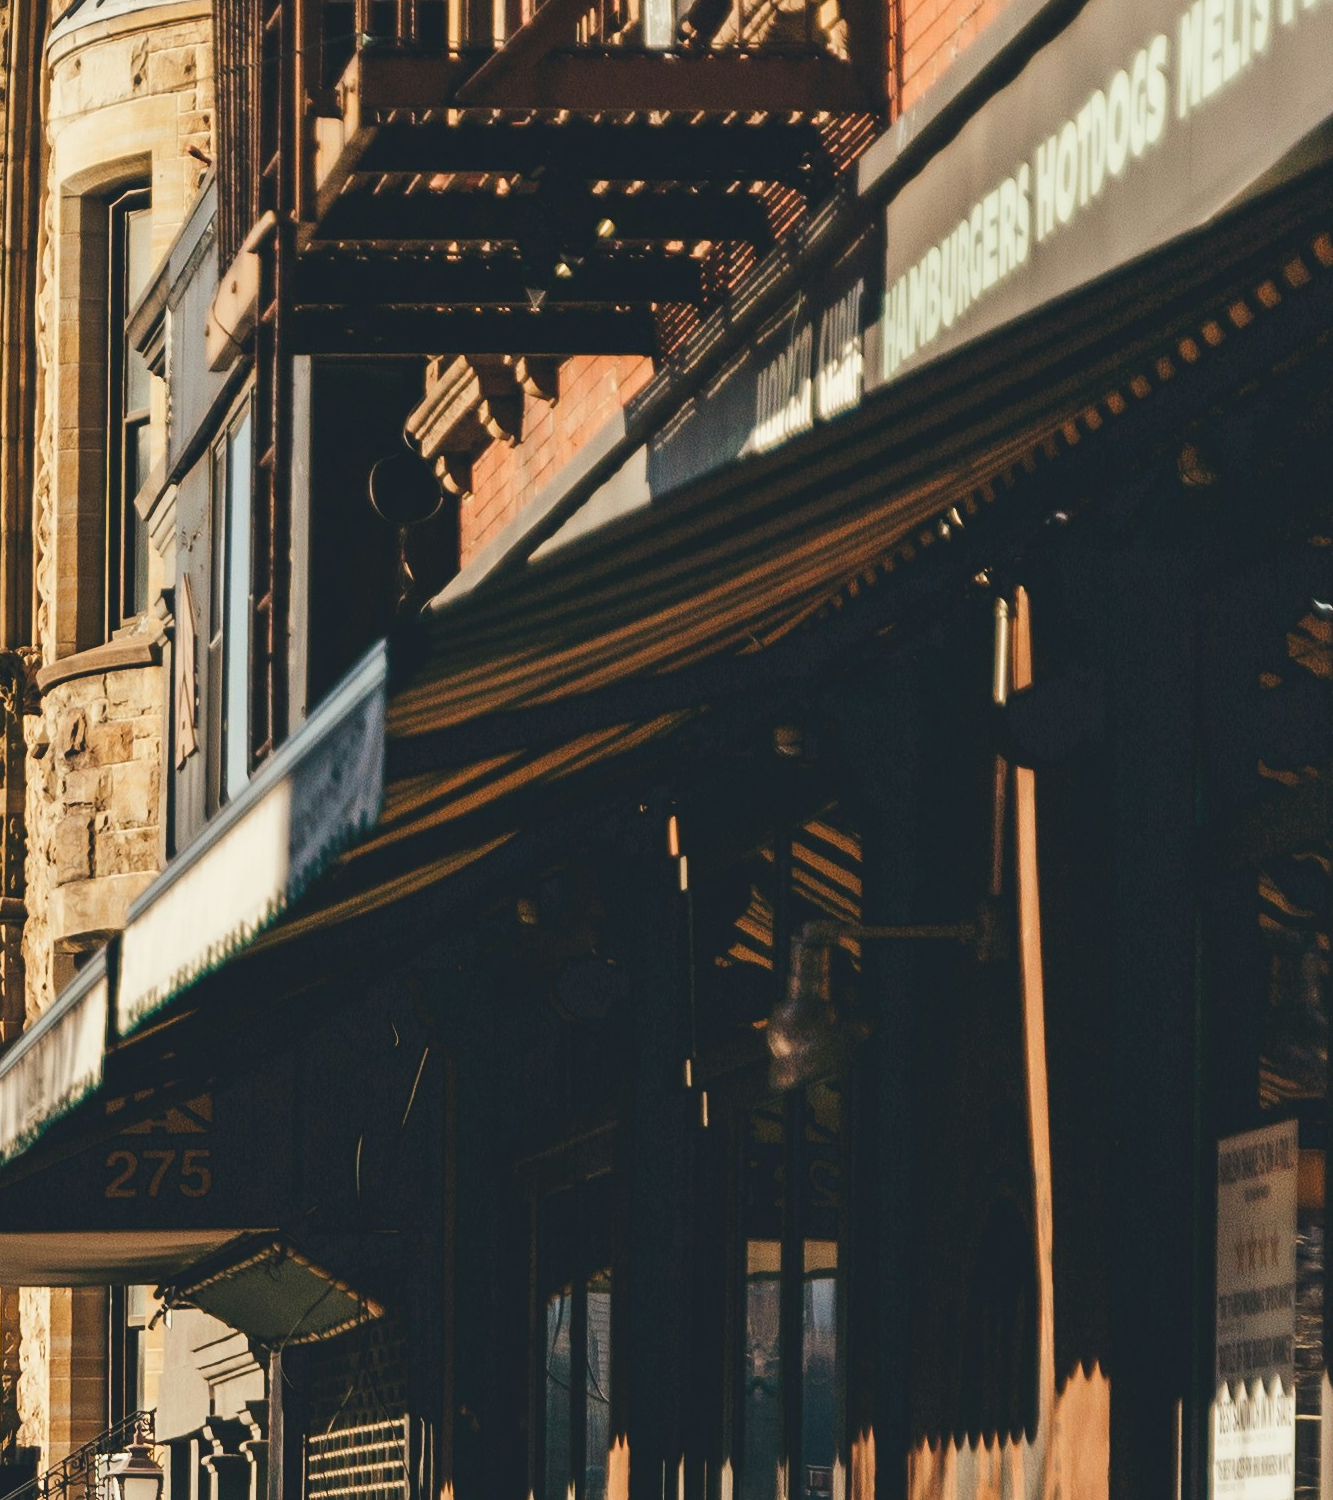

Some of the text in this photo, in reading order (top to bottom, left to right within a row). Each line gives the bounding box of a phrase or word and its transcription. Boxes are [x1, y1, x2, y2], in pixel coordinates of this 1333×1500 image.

[881, 161, 1031, 381] HAMBURGERS
[1035, 33, 1169, 243] HOTDOGS
[104, 1149, 213, 1198] 275
